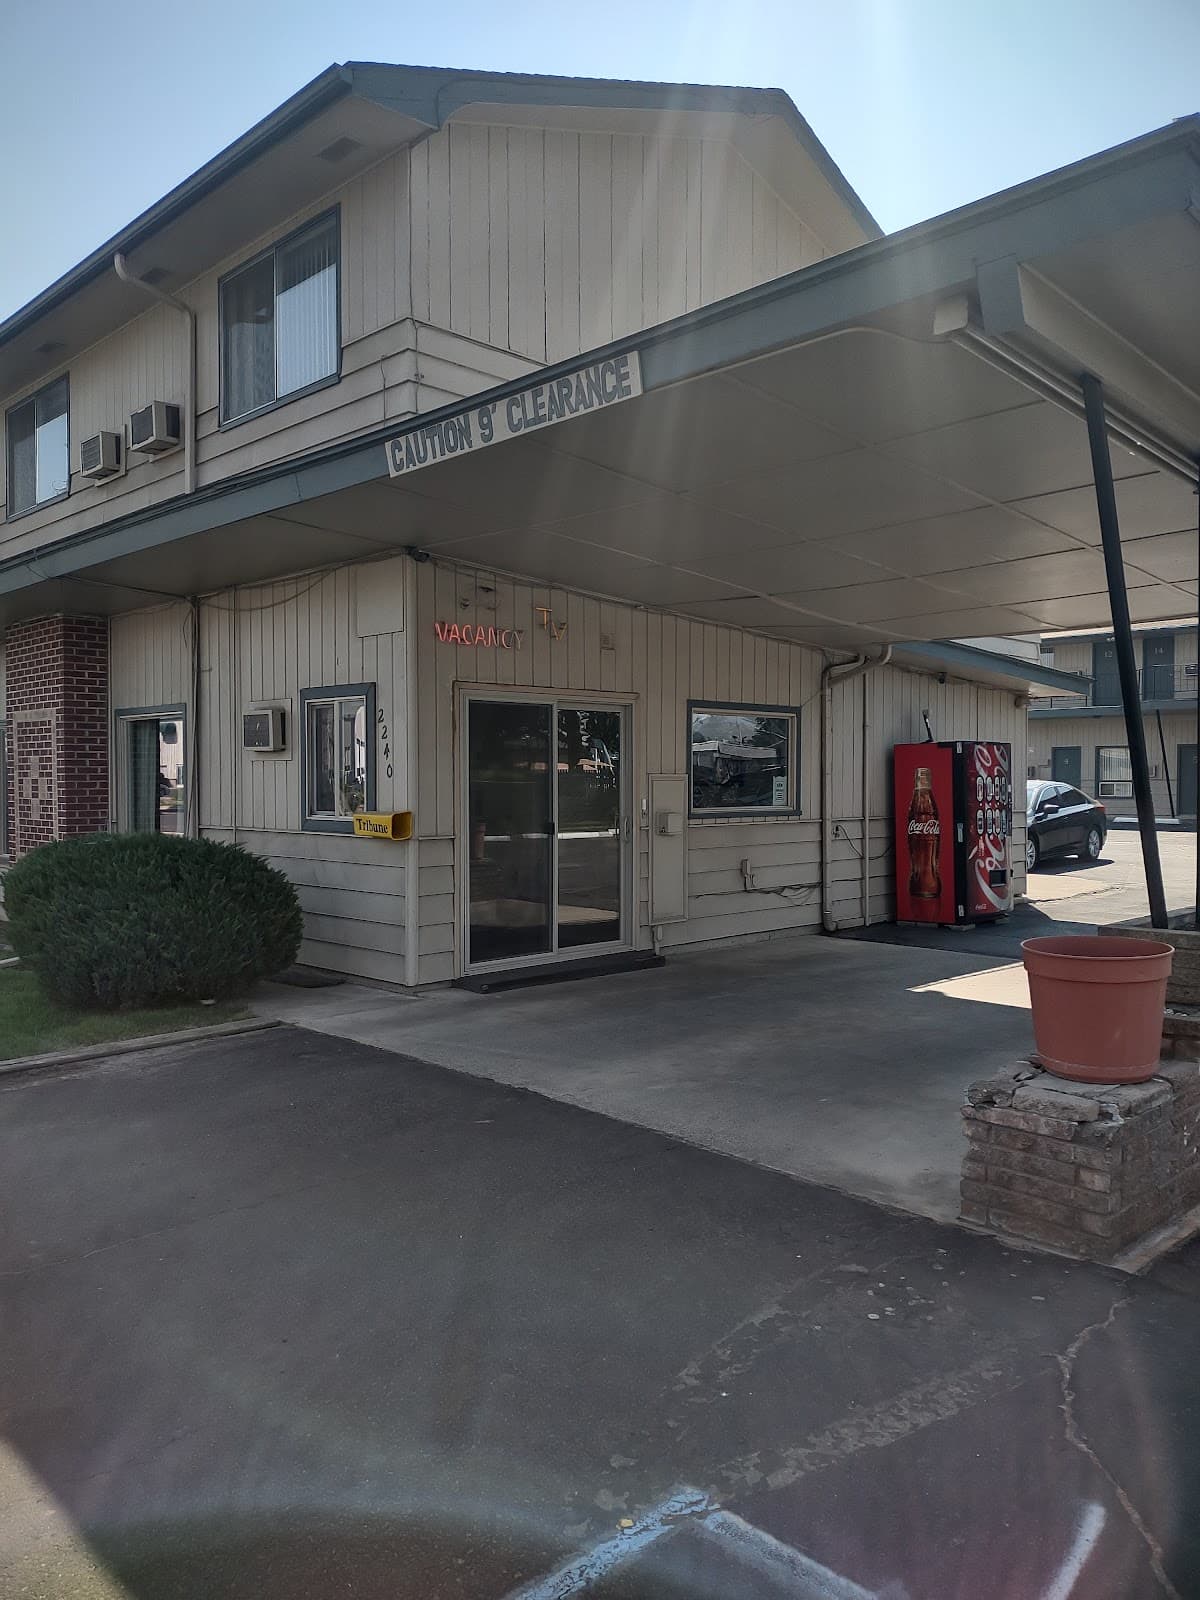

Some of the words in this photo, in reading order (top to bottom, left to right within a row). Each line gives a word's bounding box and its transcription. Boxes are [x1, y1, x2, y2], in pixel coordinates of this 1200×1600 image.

[390, 413, 472, 473] CAUTION
[478, 403, 497, 443] 9'
[506, 355, 632, 433] CLEARANCE
[435, 622, 523, 650] VACANCY
[377, 708, 393, 778] 2240
[355, 818, 389, 834] Tribune
[908, 819, 941, 835] Coca-Cola
